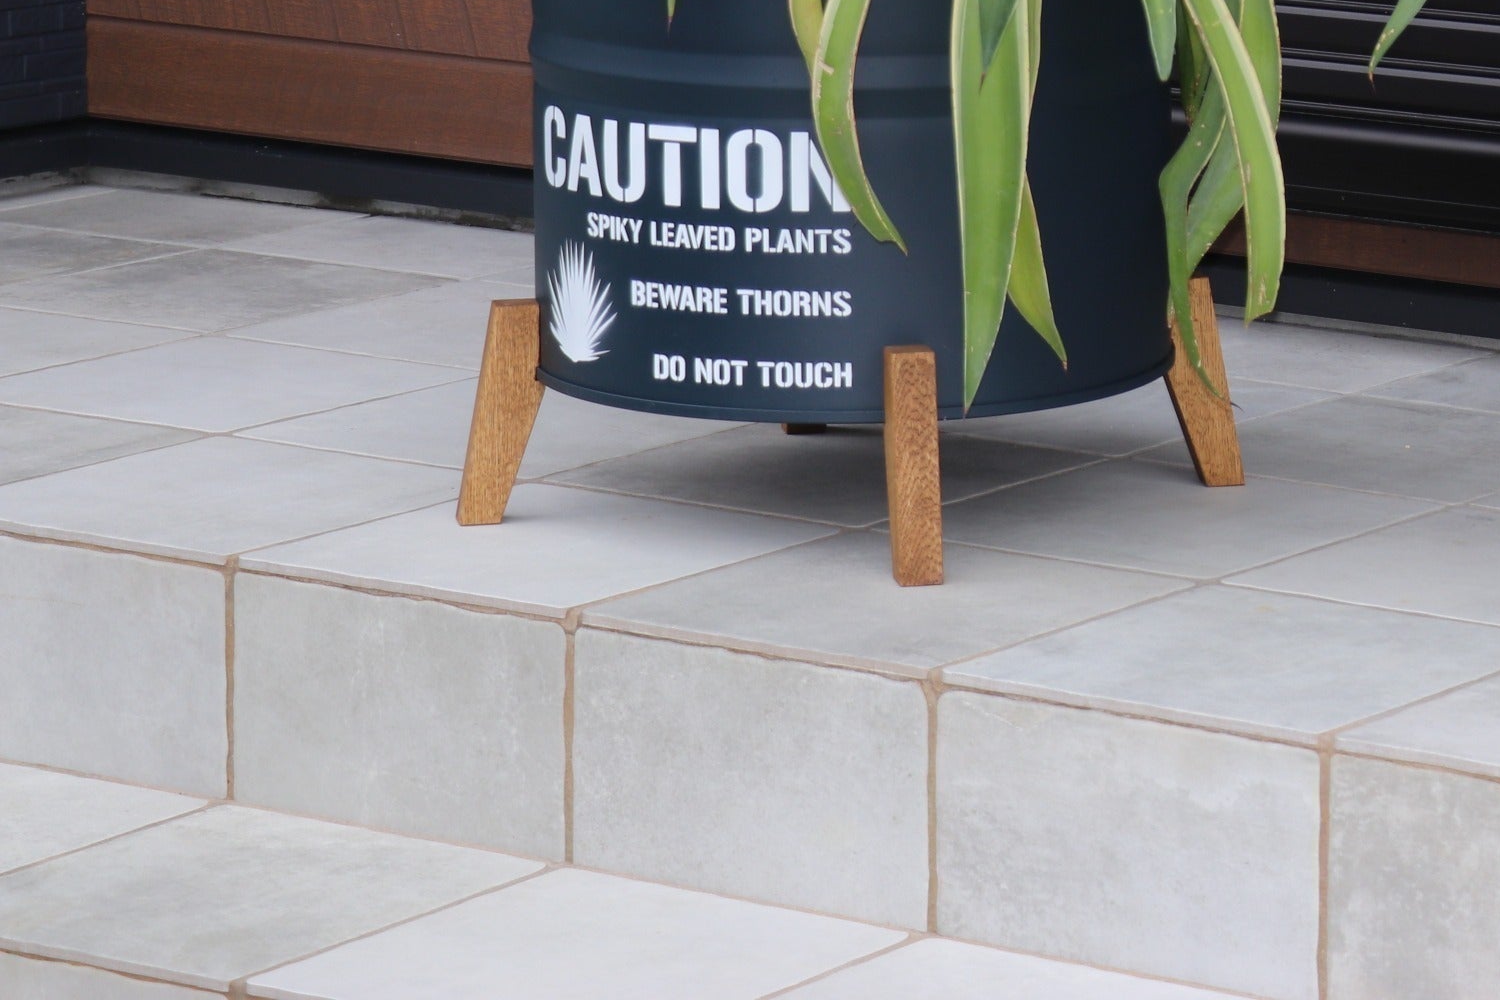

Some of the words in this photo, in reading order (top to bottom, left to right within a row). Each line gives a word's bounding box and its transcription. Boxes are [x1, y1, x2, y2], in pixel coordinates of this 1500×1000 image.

[587, 211, 644, 244] SPIKY
[650, 222, 736, 253] LEAVED
[744, 226, 853, 255] PLANTS
[630, 279, 729, 315] BEWARE
[736, 288, 853, 318] THORNS
[653, 353, 686, 383] DO
[694, 357, 748, 386] NOT
[756, 361, 853, 389] TOUCH
